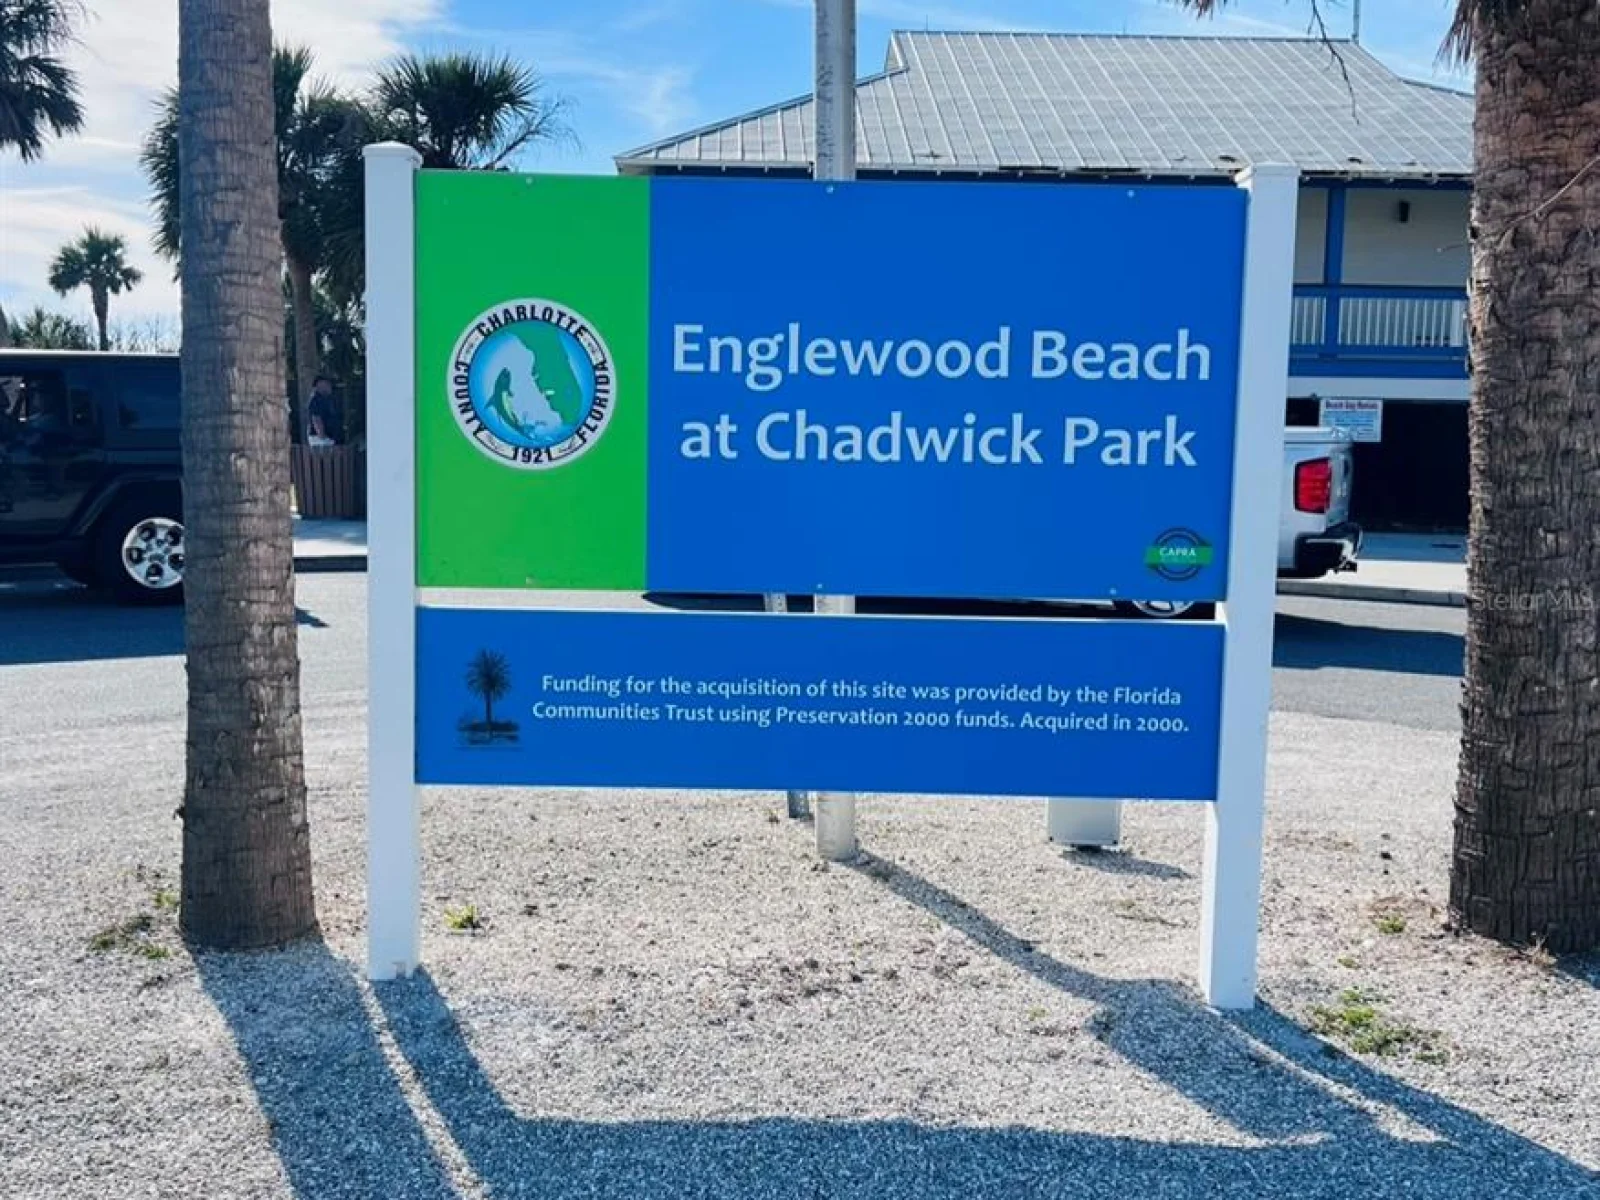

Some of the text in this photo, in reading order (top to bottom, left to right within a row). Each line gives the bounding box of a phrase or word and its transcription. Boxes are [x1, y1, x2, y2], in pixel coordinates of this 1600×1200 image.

[476, 304, 589, 339] CHARLOTTE
[673, 322, 1211, 391] Englewood Beach
[453, 360, 488, 437] COUNTY
[577, 358, 611, 445] FLORIDA
[512, 447, 552, 463] 1921
[680, 409, 1198, 466] at Chadwick Park
[542, 675, 1181, 705] Funding for the acquisition of this site was provided by the Florida
[532, 701, 1189, 732] Communities Trust using Preservation 2000 funds. Acquired in 2000.
